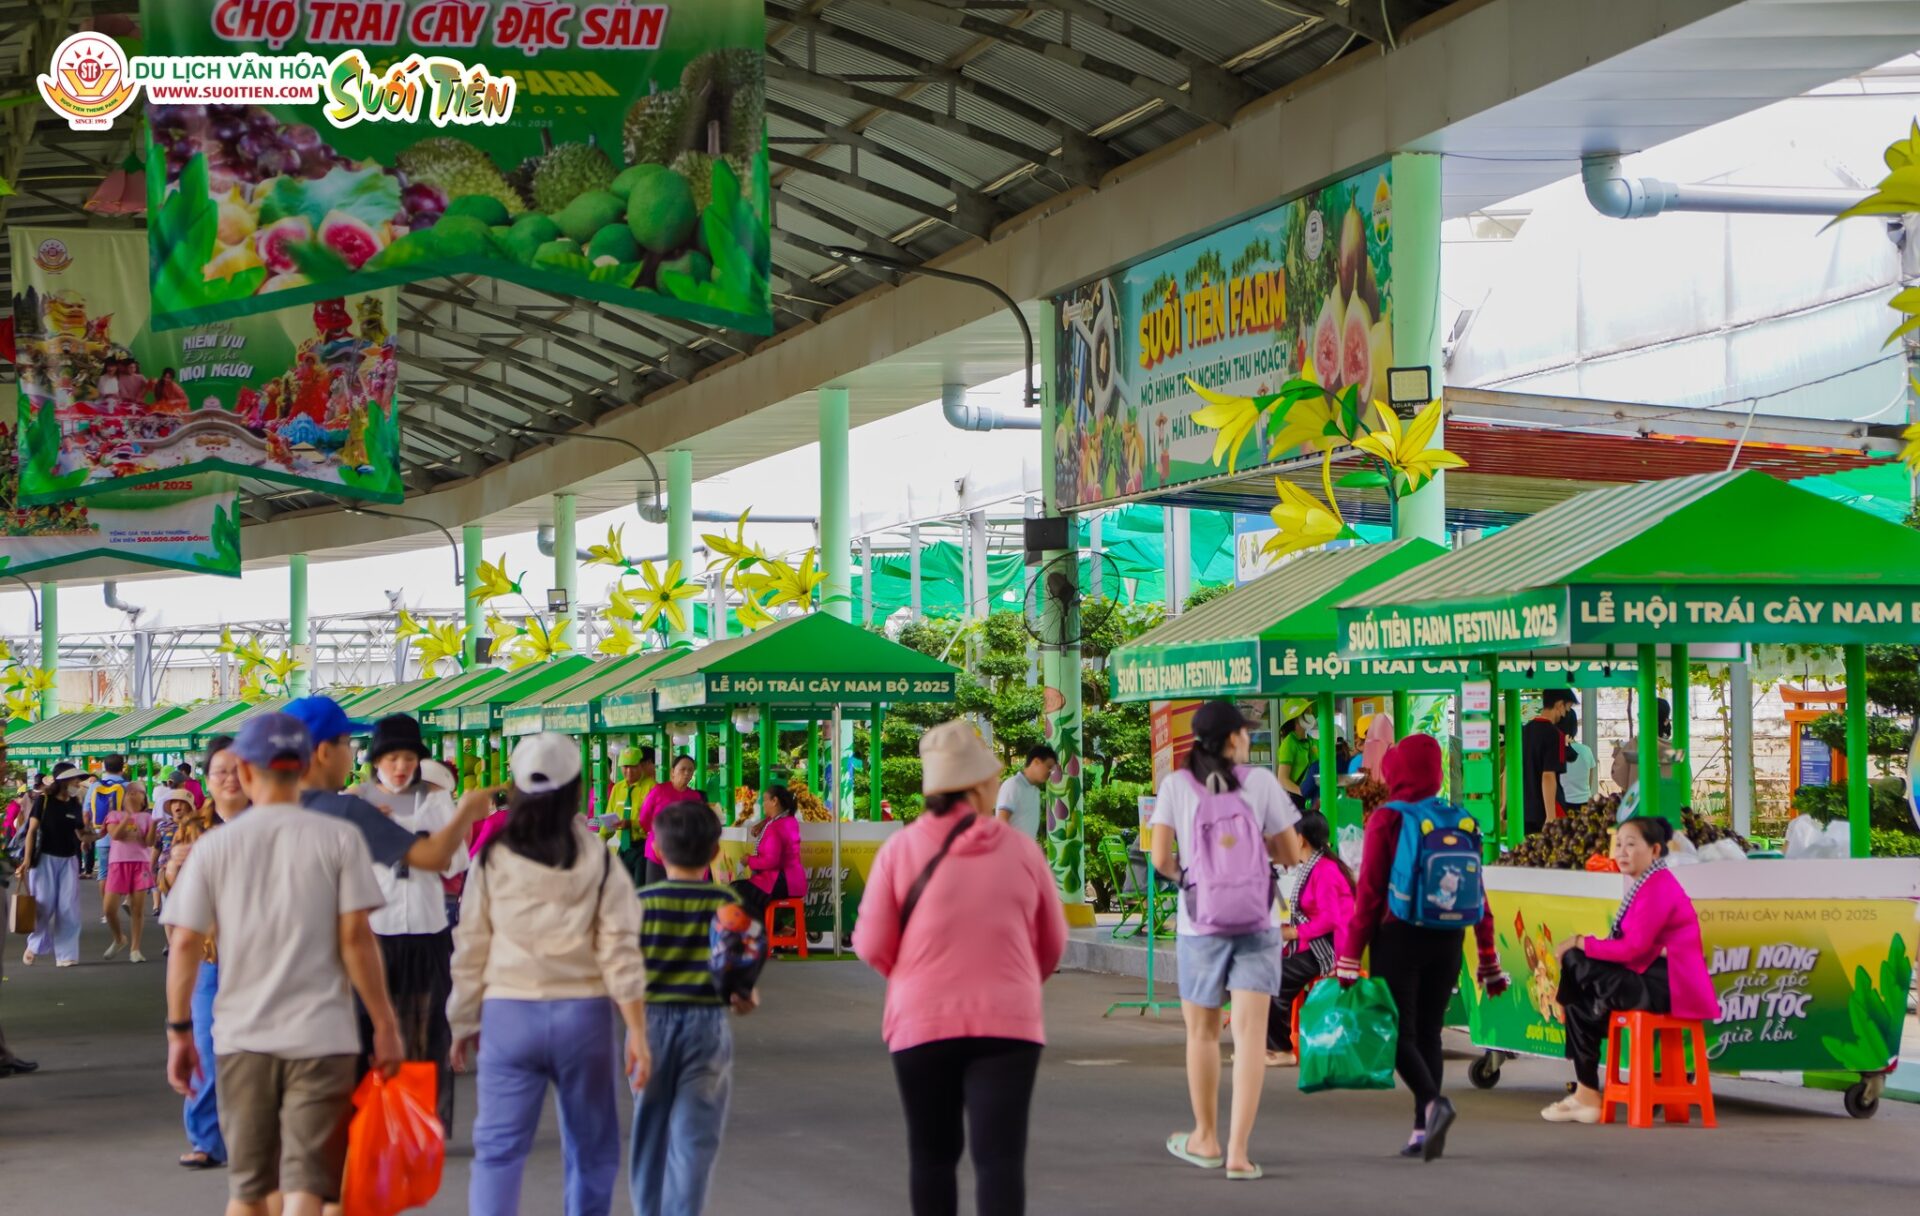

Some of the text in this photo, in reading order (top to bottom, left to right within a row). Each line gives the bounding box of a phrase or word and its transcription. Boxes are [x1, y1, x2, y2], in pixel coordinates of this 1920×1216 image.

[215, 0, 296, 46] CHỢ
[1139, 266, 1287, 370] SUỐI TIÊN FARM
[1141, 378, 1154, 408] MÔ
[1233, 353, 1252, 382] THU
[1254, 343, 1287, 379] HOẠCH
[163, 481, 193, 490] 2025
[1349, 604, 1558, 651] SUỐI TIÊN FARM FESTIVAL 2025
[1581, 591, 1615, 623] LỄ
[1624, 596, 1677, 629] HỘI
[1685, 596, 1755, 623] TRÁI
[1763, 596, 1824, 623] CÂY
[1832, 602, 1902, 623] NAM
[1160, 663, 1185, 690] FARM
[1186, 659, 1228, 688] FESTIVAL
[1229, 656, 1252, 684] 2025
[1269, 649, 1299, 675] LỄ
[711, 675, 950, 695] LỄ HỘI TRÁI CÂY NAM BỘ 2025
[1753, 908, 1781, 921] CÂY
[1784, 910, 1816, 921] NAM
[1847, 909, 1878, 921] 2025
